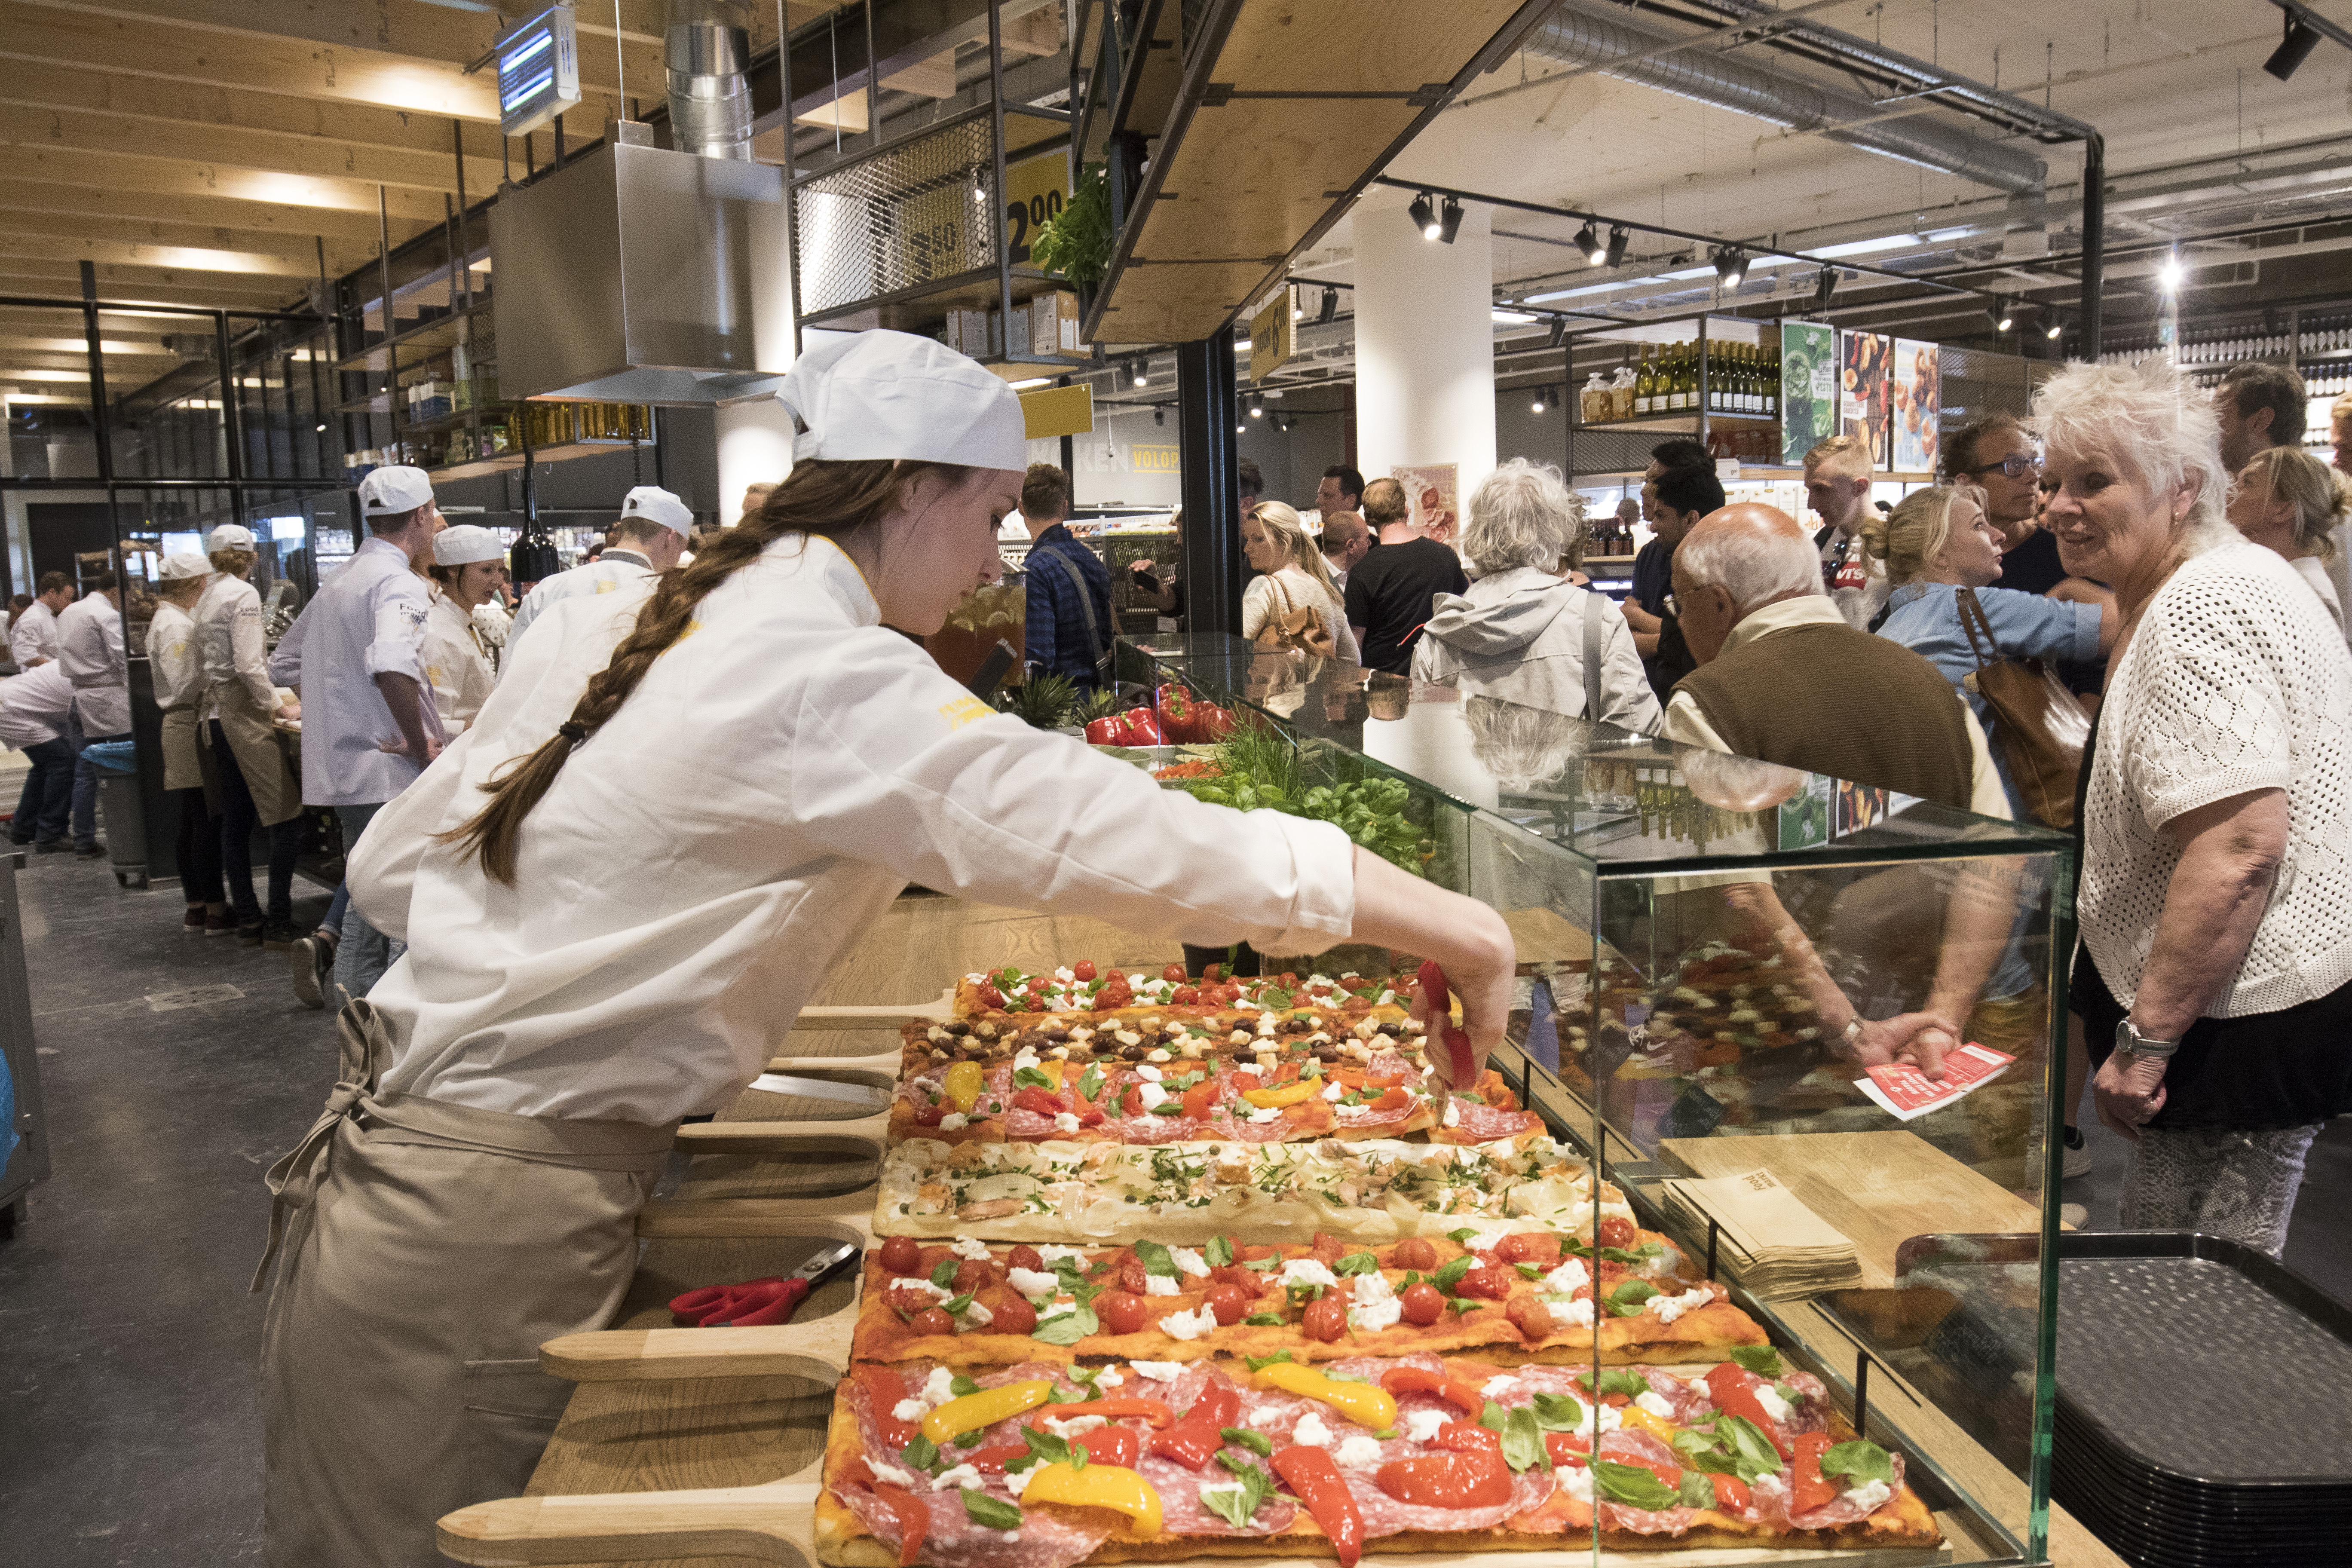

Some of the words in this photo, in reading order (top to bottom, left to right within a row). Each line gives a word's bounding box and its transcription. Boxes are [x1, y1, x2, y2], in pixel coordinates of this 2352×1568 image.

[1133, 450, 1179, 468] VOLOP
[1742, 1175, 1767, 1191] Food
[1755, 1171, 1776, 1188] markt
